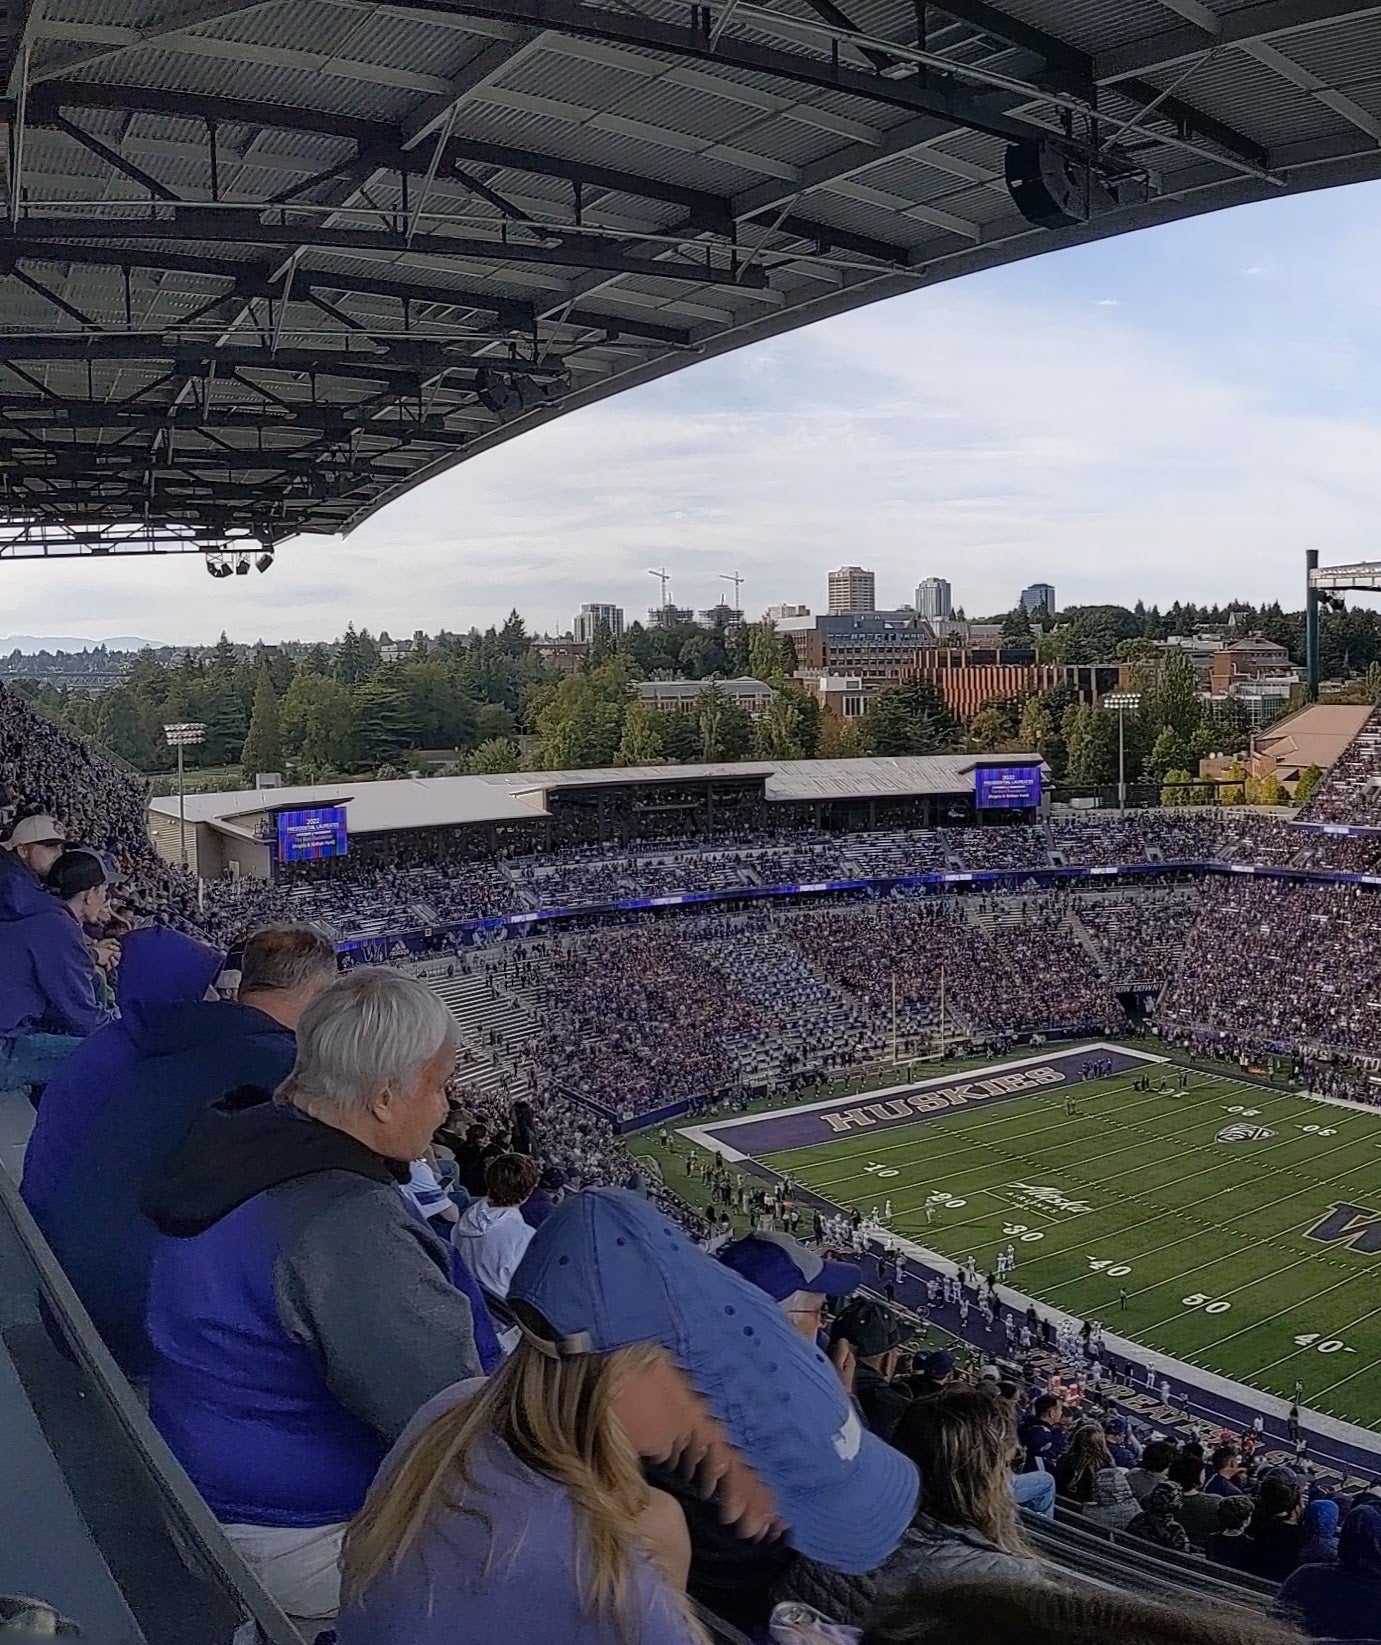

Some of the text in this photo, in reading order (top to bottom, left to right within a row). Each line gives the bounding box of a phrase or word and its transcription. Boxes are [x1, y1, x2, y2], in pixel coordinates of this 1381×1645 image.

[820, 1066, 1066, 1132] HUSKIES
[1182, 1293, 1232, 1314] 50
[1293, 1333, 1345, 1353] 40
